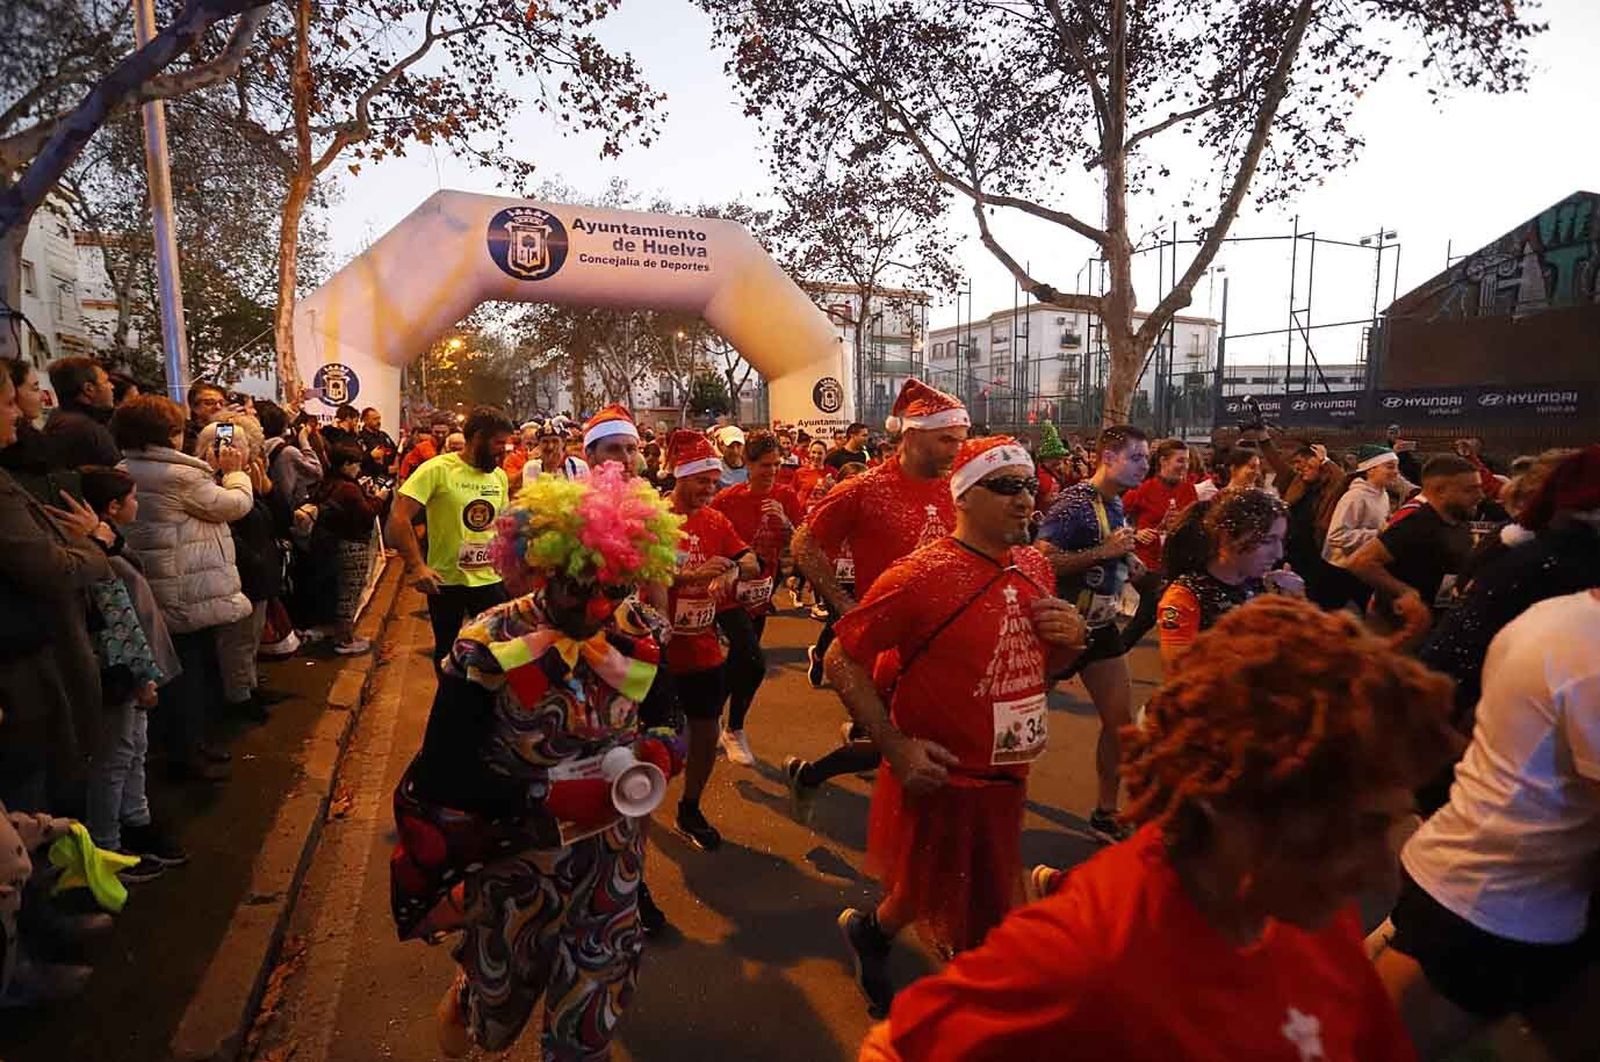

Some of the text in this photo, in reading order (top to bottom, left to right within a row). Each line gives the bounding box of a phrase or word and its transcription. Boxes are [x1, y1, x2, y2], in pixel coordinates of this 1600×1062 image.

[571, 218, 707, 241] Ayuntamiento
[612, 238, 707, 258] de Huelva
[643, 259, 657, 268] de
[660, 260, 709, 272] Deportes
[1310, 400, 1357, 409] HYUNDAI
[1404, 396, 1463, 407] HYUNDAI
[1506, 392, 1578, 405] HYUNDAI
[815, 426, 828, 434] de
